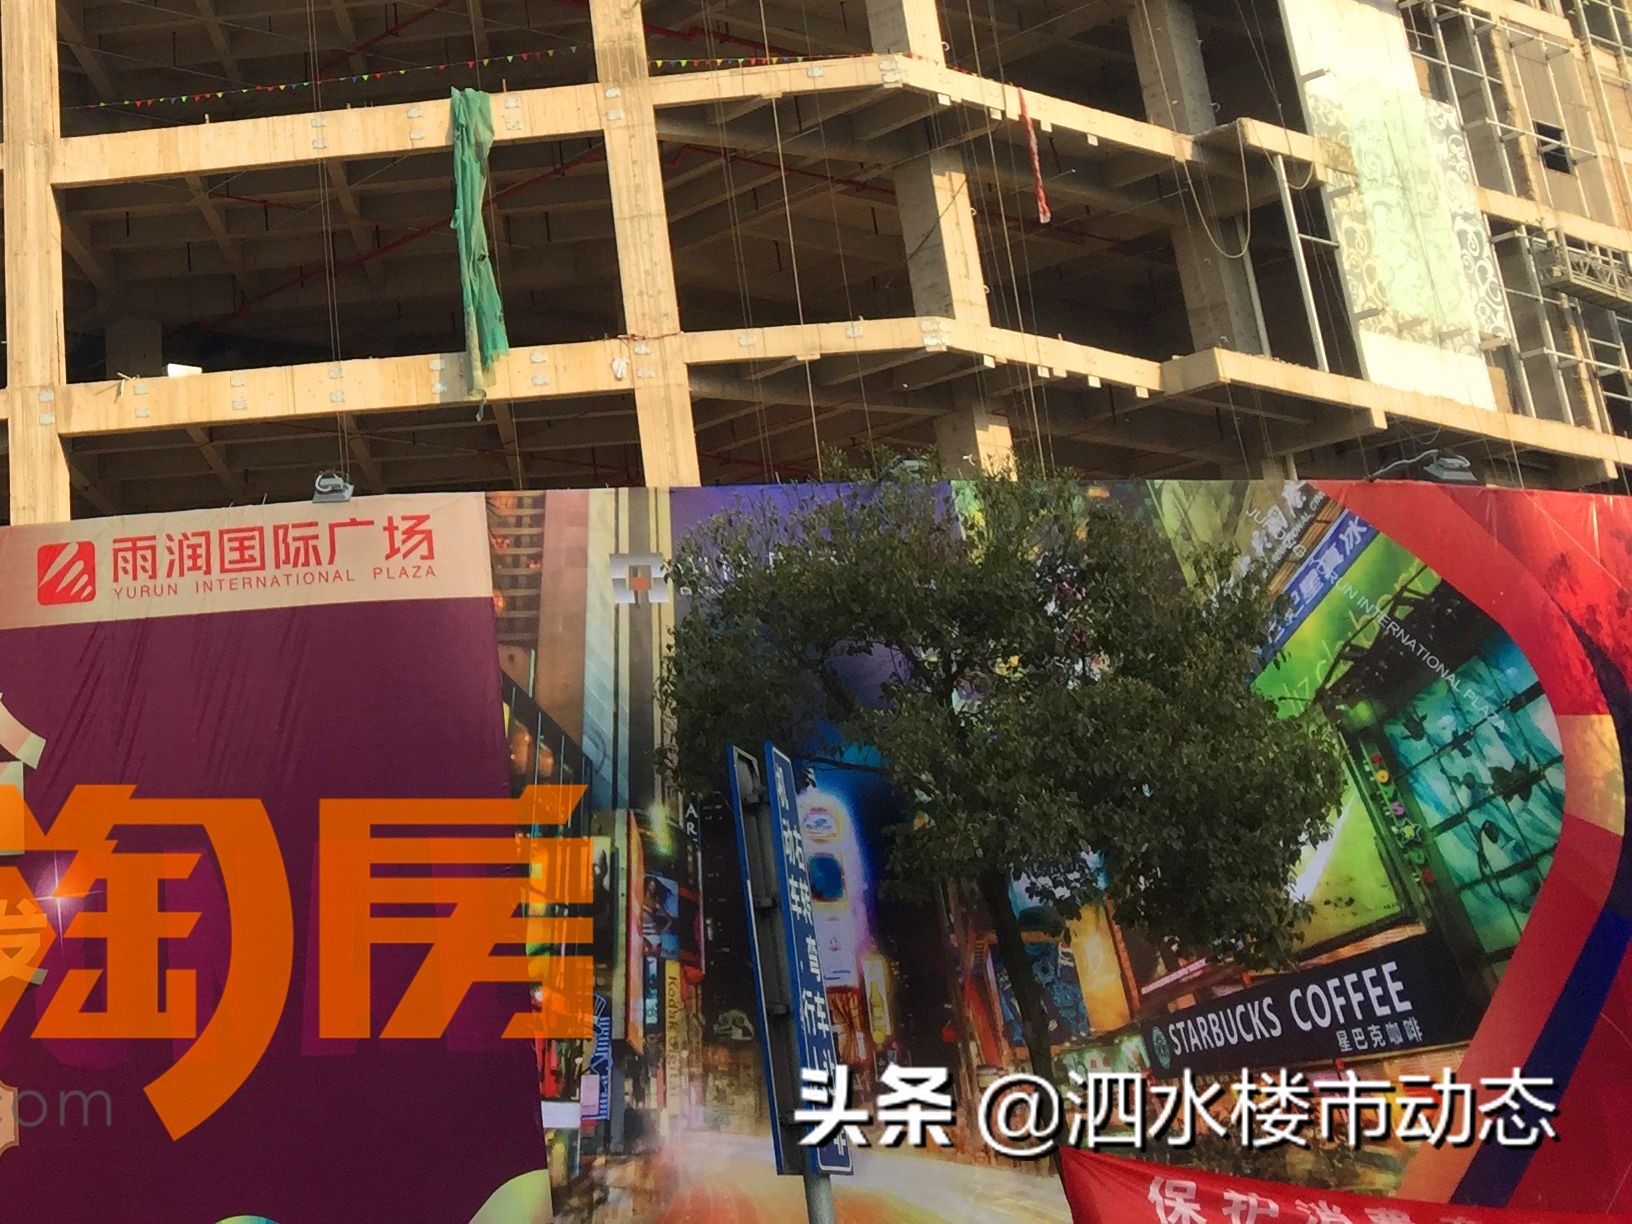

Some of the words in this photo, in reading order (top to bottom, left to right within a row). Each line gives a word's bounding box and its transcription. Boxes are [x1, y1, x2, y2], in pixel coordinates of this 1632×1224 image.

[112, 513, 436, 583] 雨润国际广场
[114, 582, 179, 600] YURUN
[194, 569, 356, 594] INTERNATIONAL
[373, 563, 437, 581] PLAZA
[1357, 595, 1460, 693] INTERNATIONAL
[1168, 996, 1282, 1056] STARBUCKS
[1289, 960, 1413, 1032] COFFEE
[1335, 1016, 1424, 1053] 星巴克咖啡
